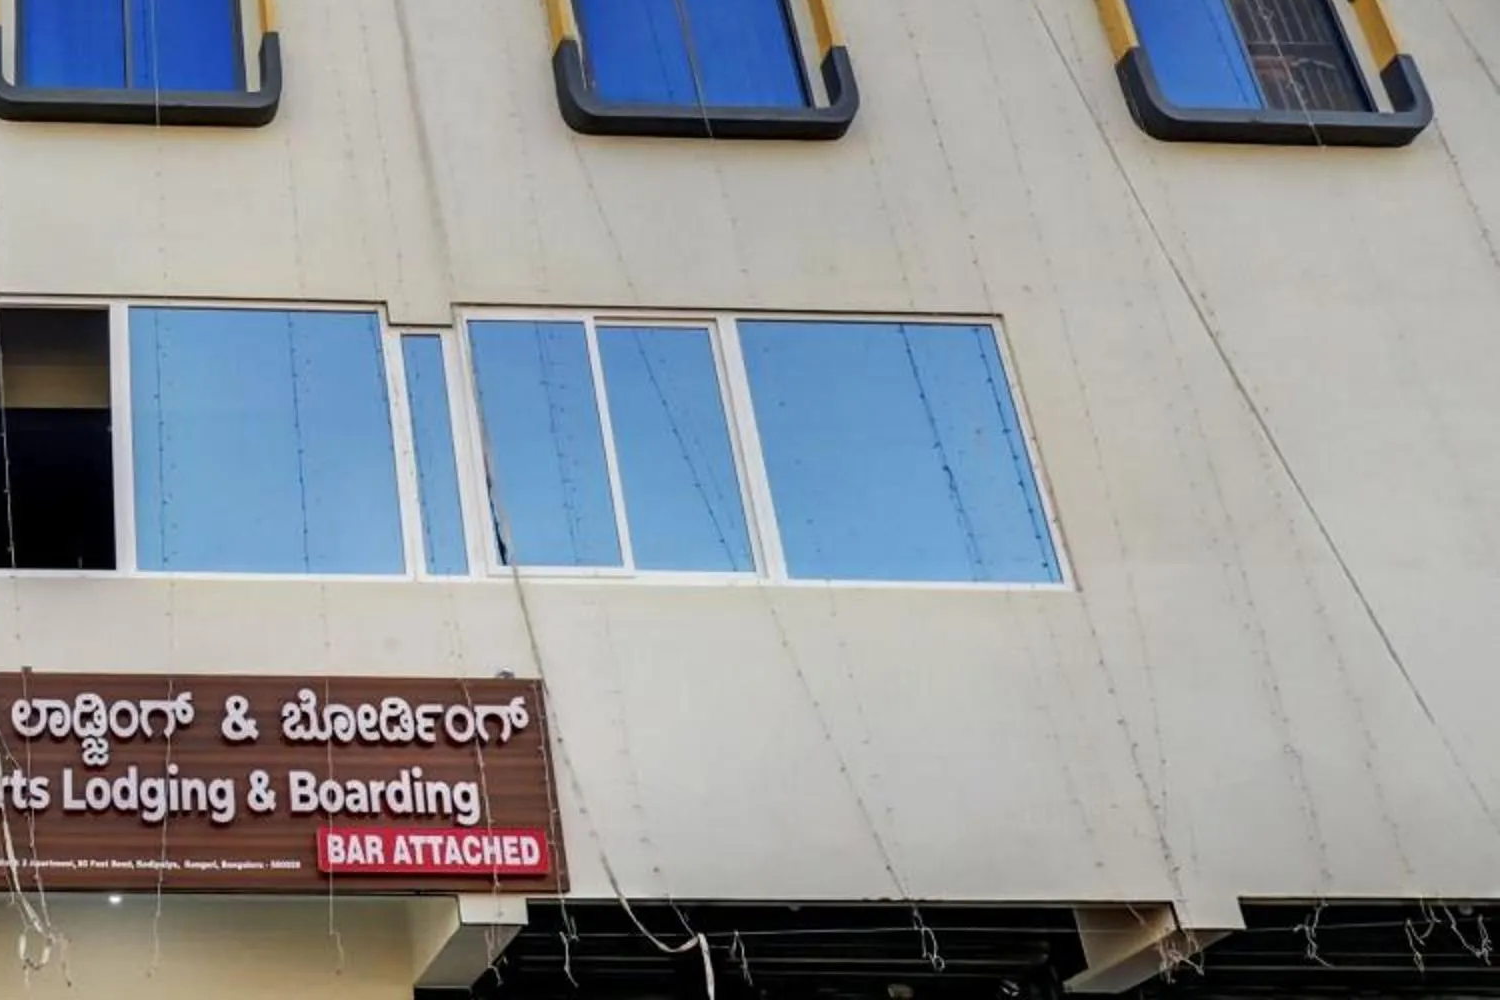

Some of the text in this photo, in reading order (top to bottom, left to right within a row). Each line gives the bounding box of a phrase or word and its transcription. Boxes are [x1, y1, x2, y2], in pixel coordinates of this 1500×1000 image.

[11, 691, 195, 765] ಲಾಡ್ಜಿಂಗ್
[221, 695, 259, 741] &
[282, 688, 529, 742] ಬೋರ್ಡಿಂಗ್
[63, 765, 235, 823] Lodging
[247, 770, 276, 812] &
[289, 767, 480, 826] Boarding
[327, 833, 540, 867] BAR ATTACHED
